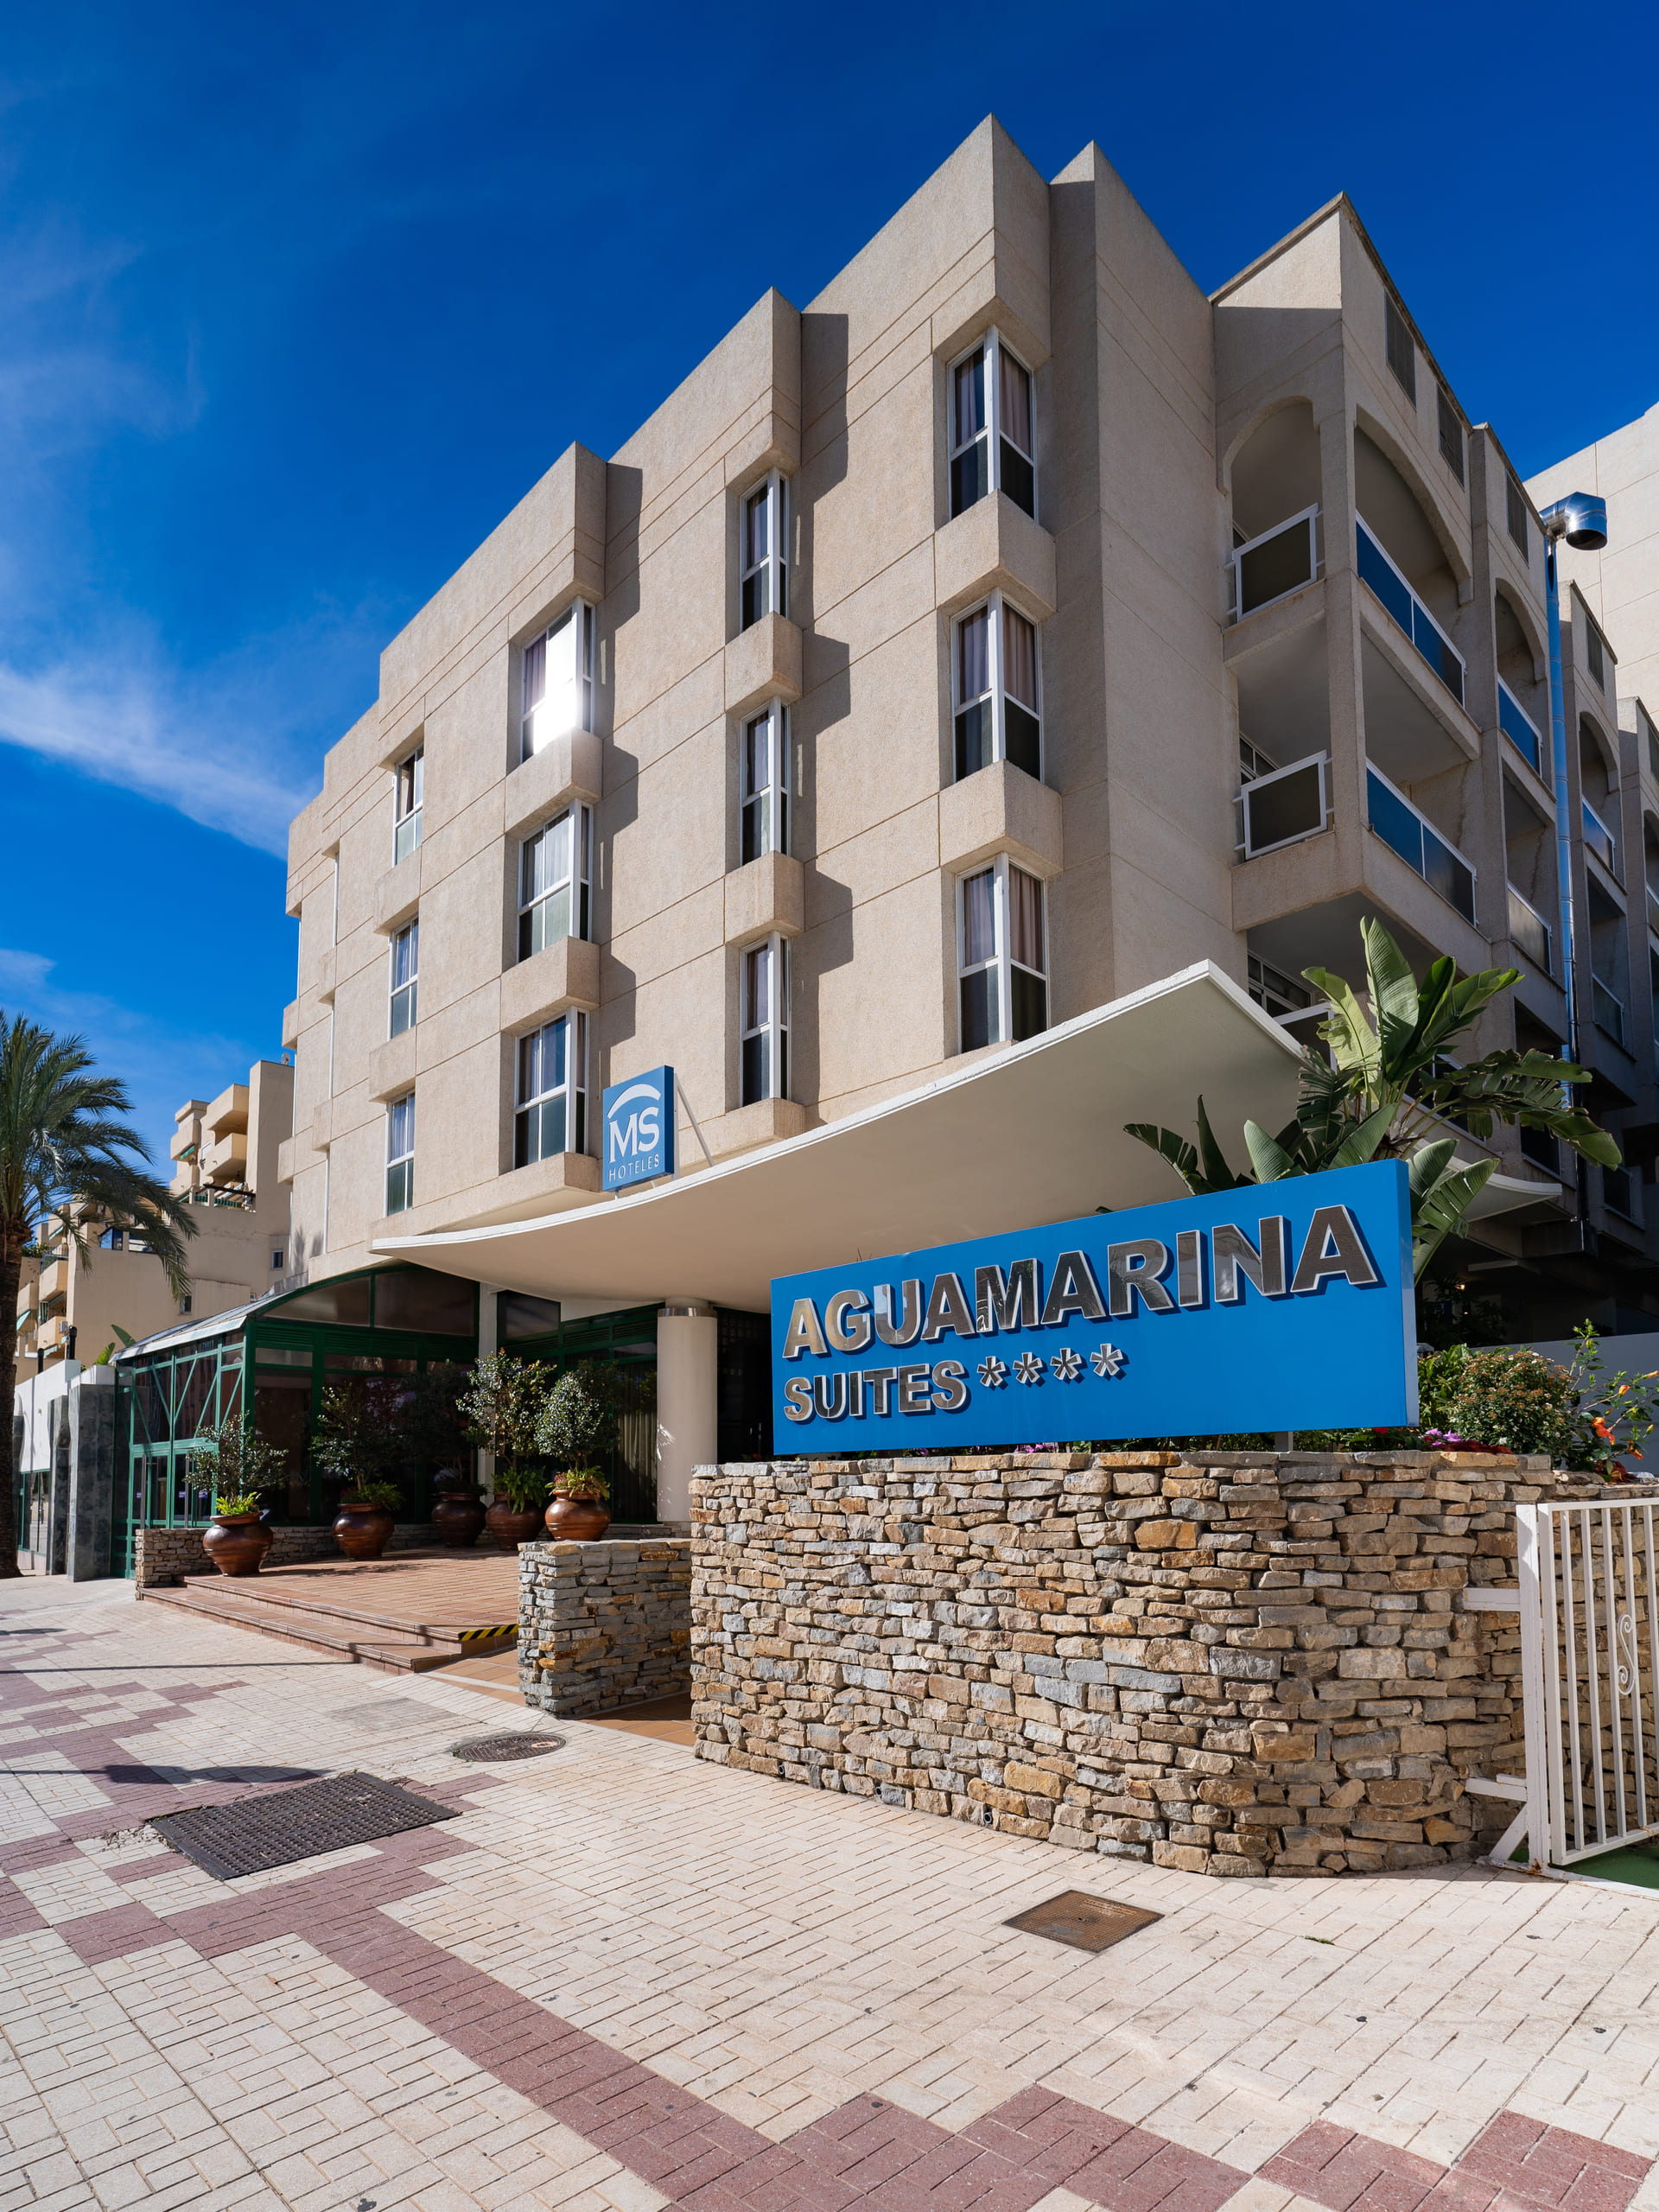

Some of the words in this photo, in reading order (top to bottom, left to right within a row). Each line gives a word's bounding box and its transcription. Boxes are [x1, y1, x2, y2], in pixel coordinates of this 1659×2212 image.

[609, 1107, 659, 1163] MS
[608, 1154, 659, 1182] HOTELES
[782, 1204, 1379, 1358] AGUAMARINA
[783, 1360, 967, 1421] SUITES
